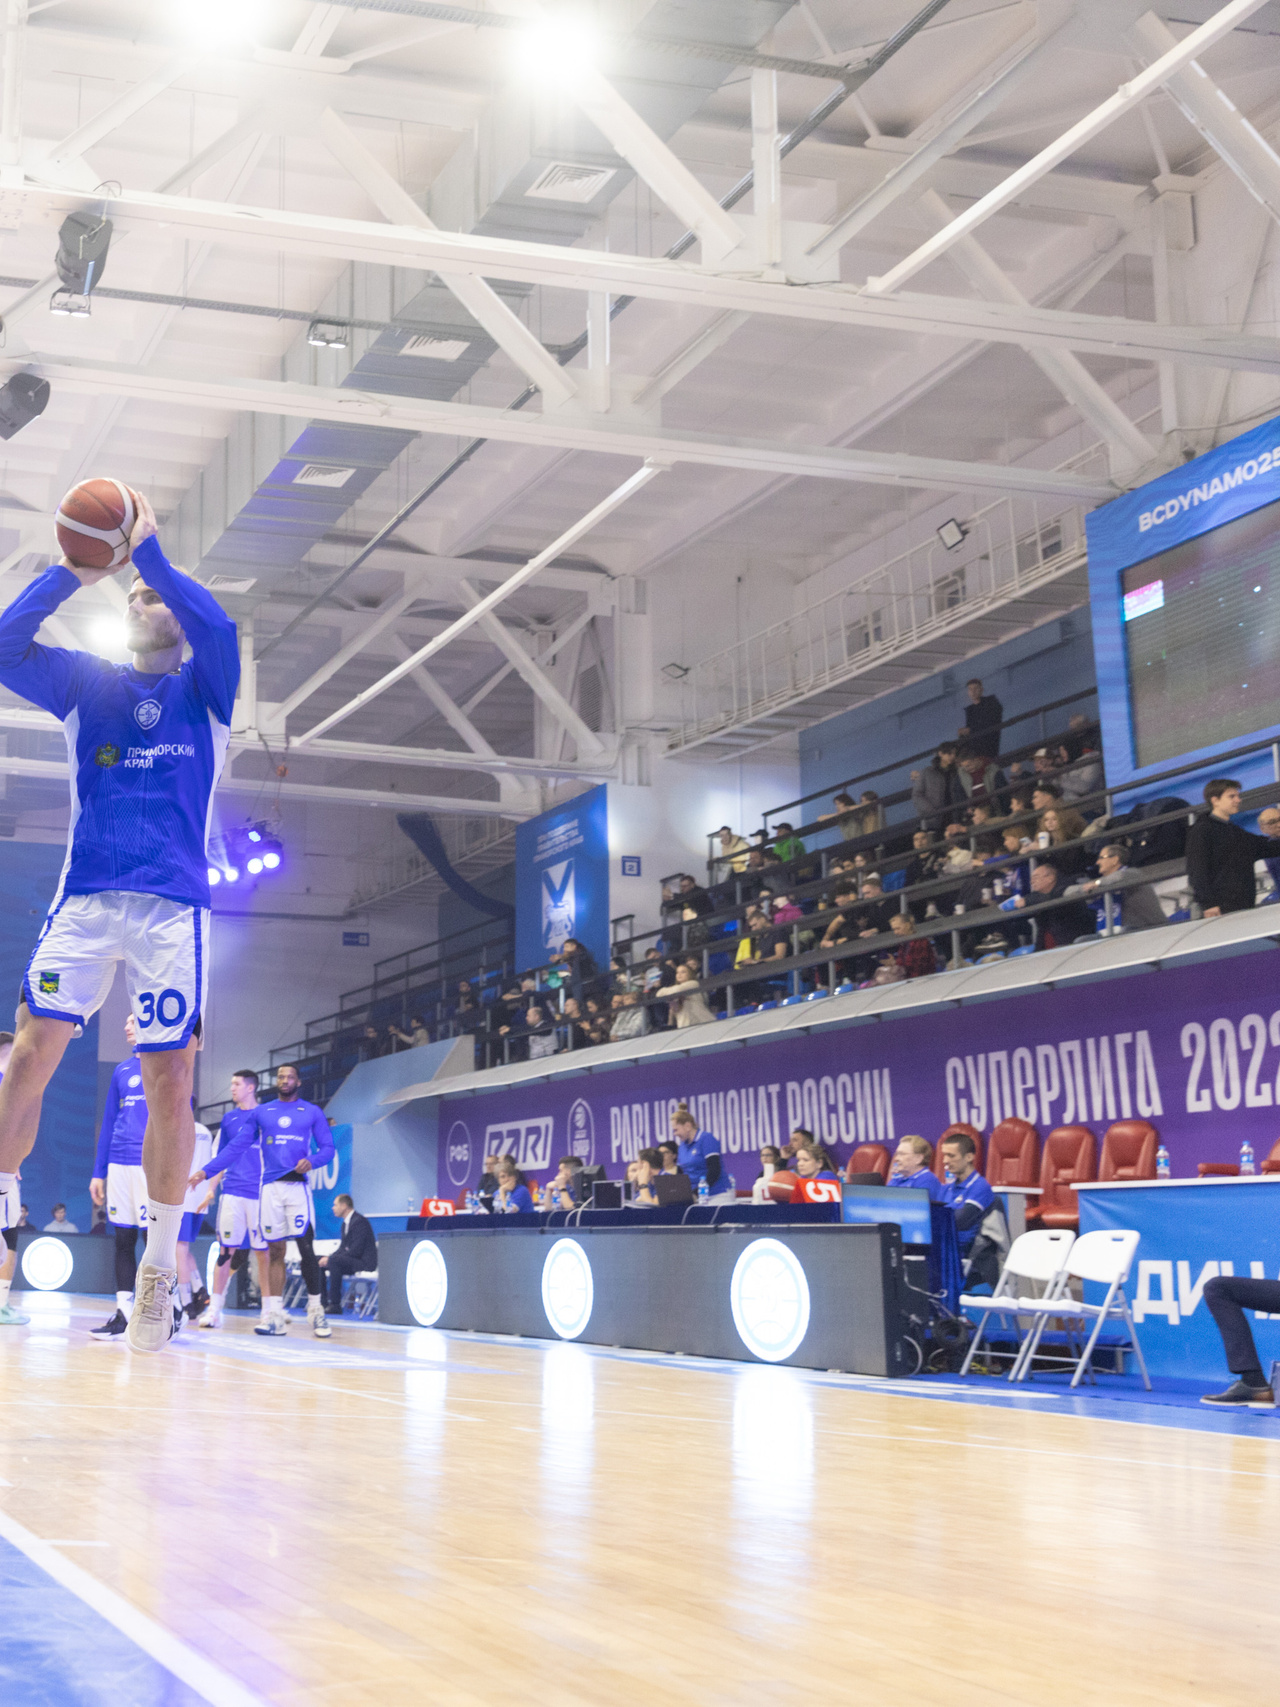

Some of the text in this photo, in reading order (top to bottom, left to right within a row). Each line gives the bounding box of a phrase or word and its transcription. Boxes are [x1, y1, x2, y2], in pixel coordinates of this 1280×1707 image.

[127, 744, 195, 758] ПРИМОРСКИЙ
[124, 756, 154, 769] КРАЙ
[137, 988, 187, 1028] 30
[610, 1102, 651, 1163] PARI
[786, 1067, 895, 1146] РОССИИ
[294, 1214, 305, 1229] 6
